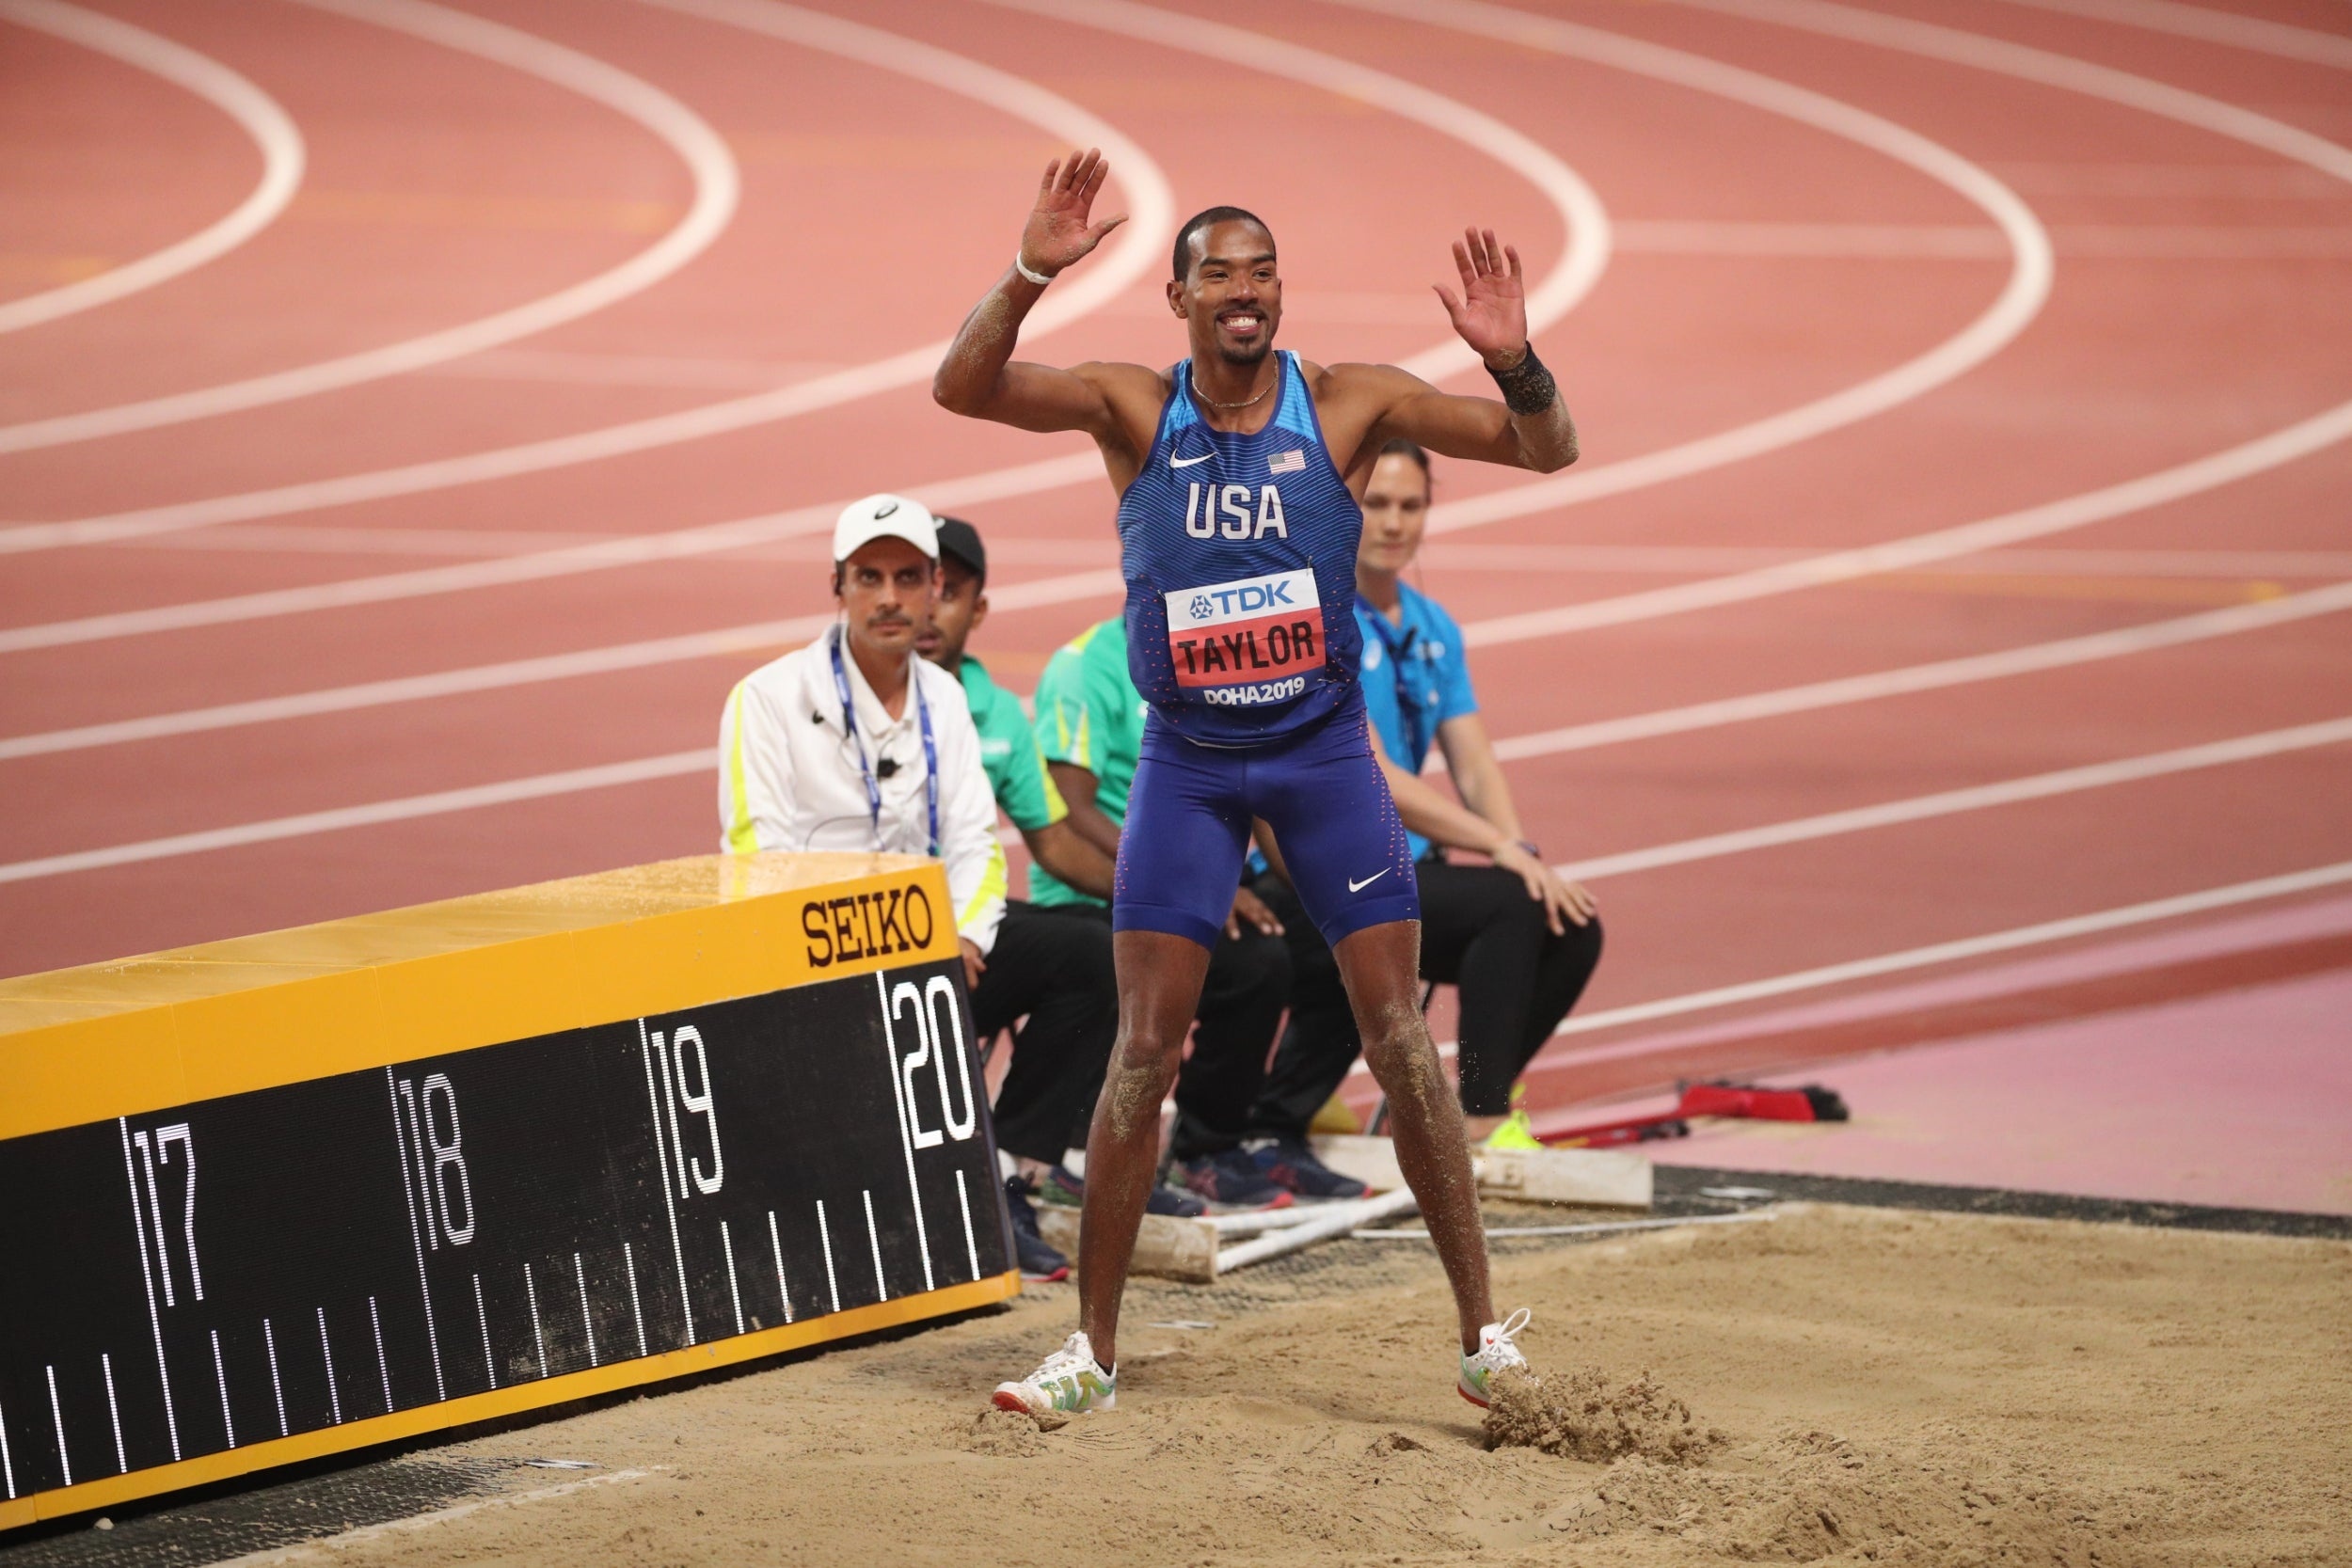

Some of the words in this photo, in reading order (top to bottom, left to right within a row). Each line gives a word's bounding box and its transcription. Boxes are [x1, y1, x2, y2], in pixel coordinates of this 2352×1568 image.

[1186, 483, 1288, 540] USA
[1212, 579, 1295, 615] TDK
[1178, 621, 1315, 674] TAYLOR
[802, 882, 934, 968] SEIKO
[135, 1122, 203, 1307] 17
[399, 1072, 475, 1251] 18
[650, 1024, 723, 1199] 19
[891, 974, 977, 1149] 20
